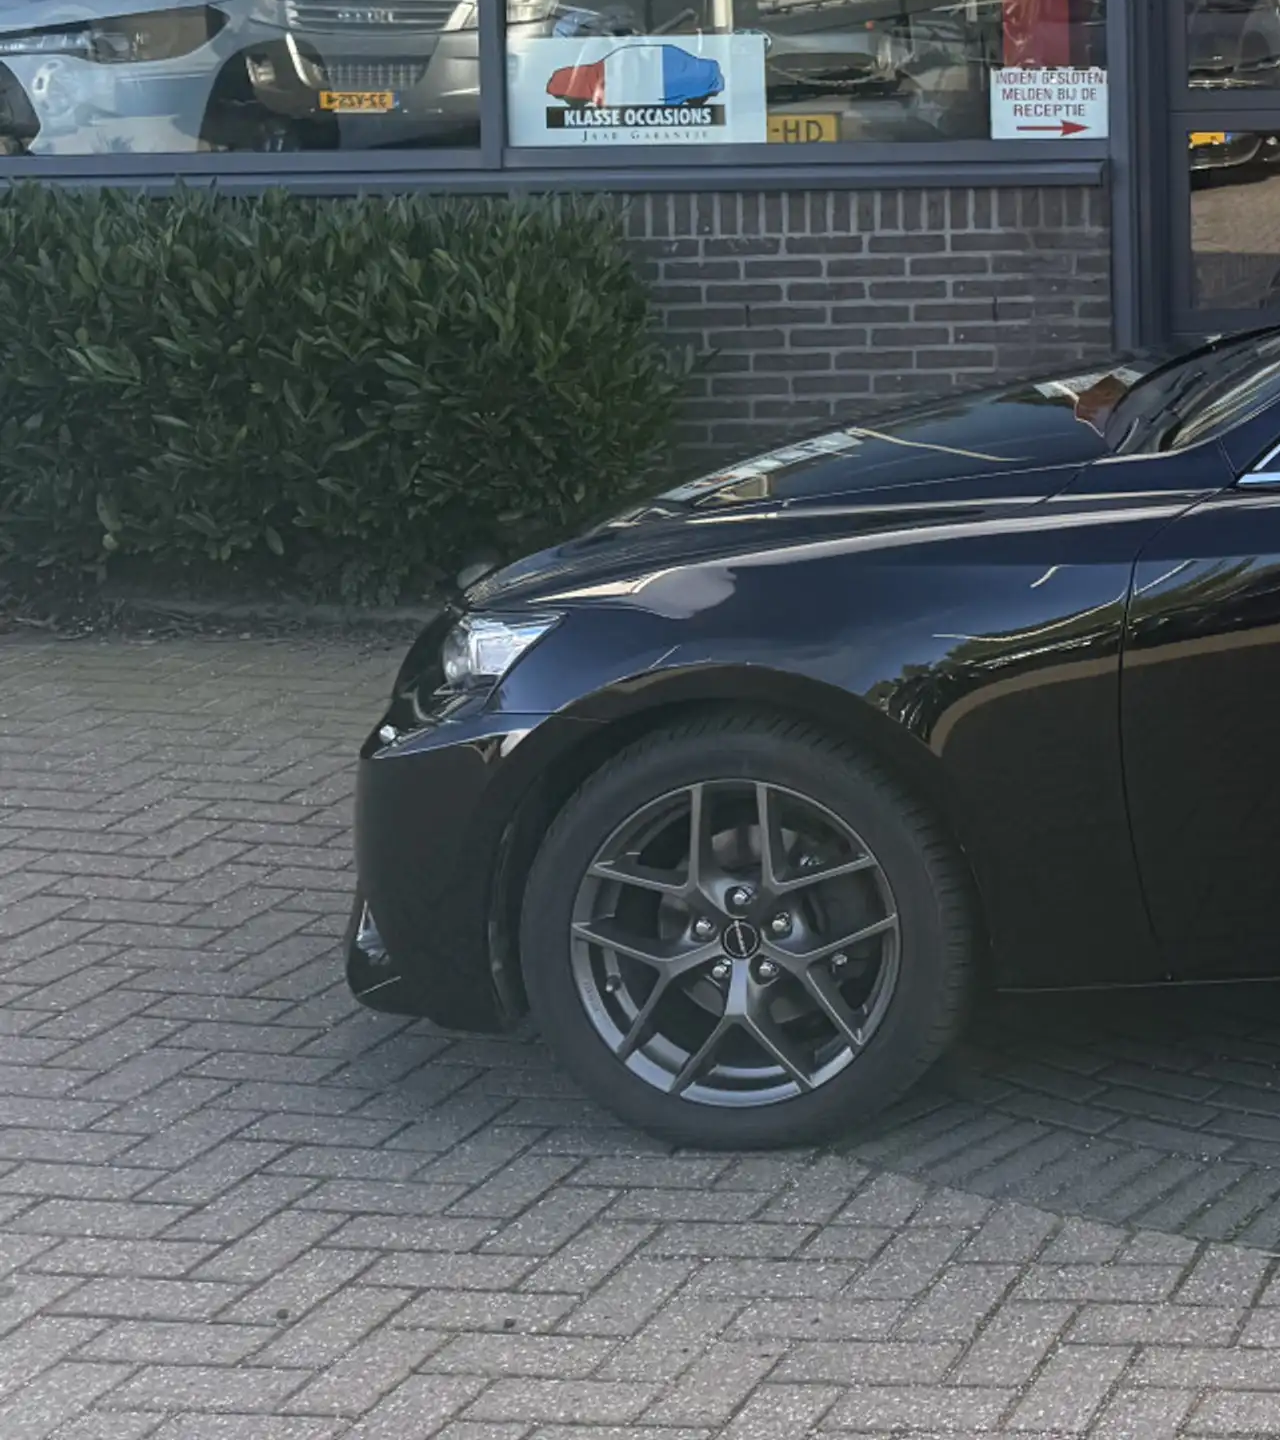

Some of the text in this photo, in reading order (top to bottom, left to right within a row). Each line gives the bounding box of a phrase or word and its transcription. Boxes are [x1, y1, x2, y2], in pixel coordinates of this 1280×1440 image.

[996, 71, 1103, 85] INDIEN GESLOTEN
[1002, 87, 1097, 101] MELDEN BIJ DE
[564, 107, 712, 126] KLASSE OCCASIONS
[1013, 103, 1086, 117] RECEPTIE
